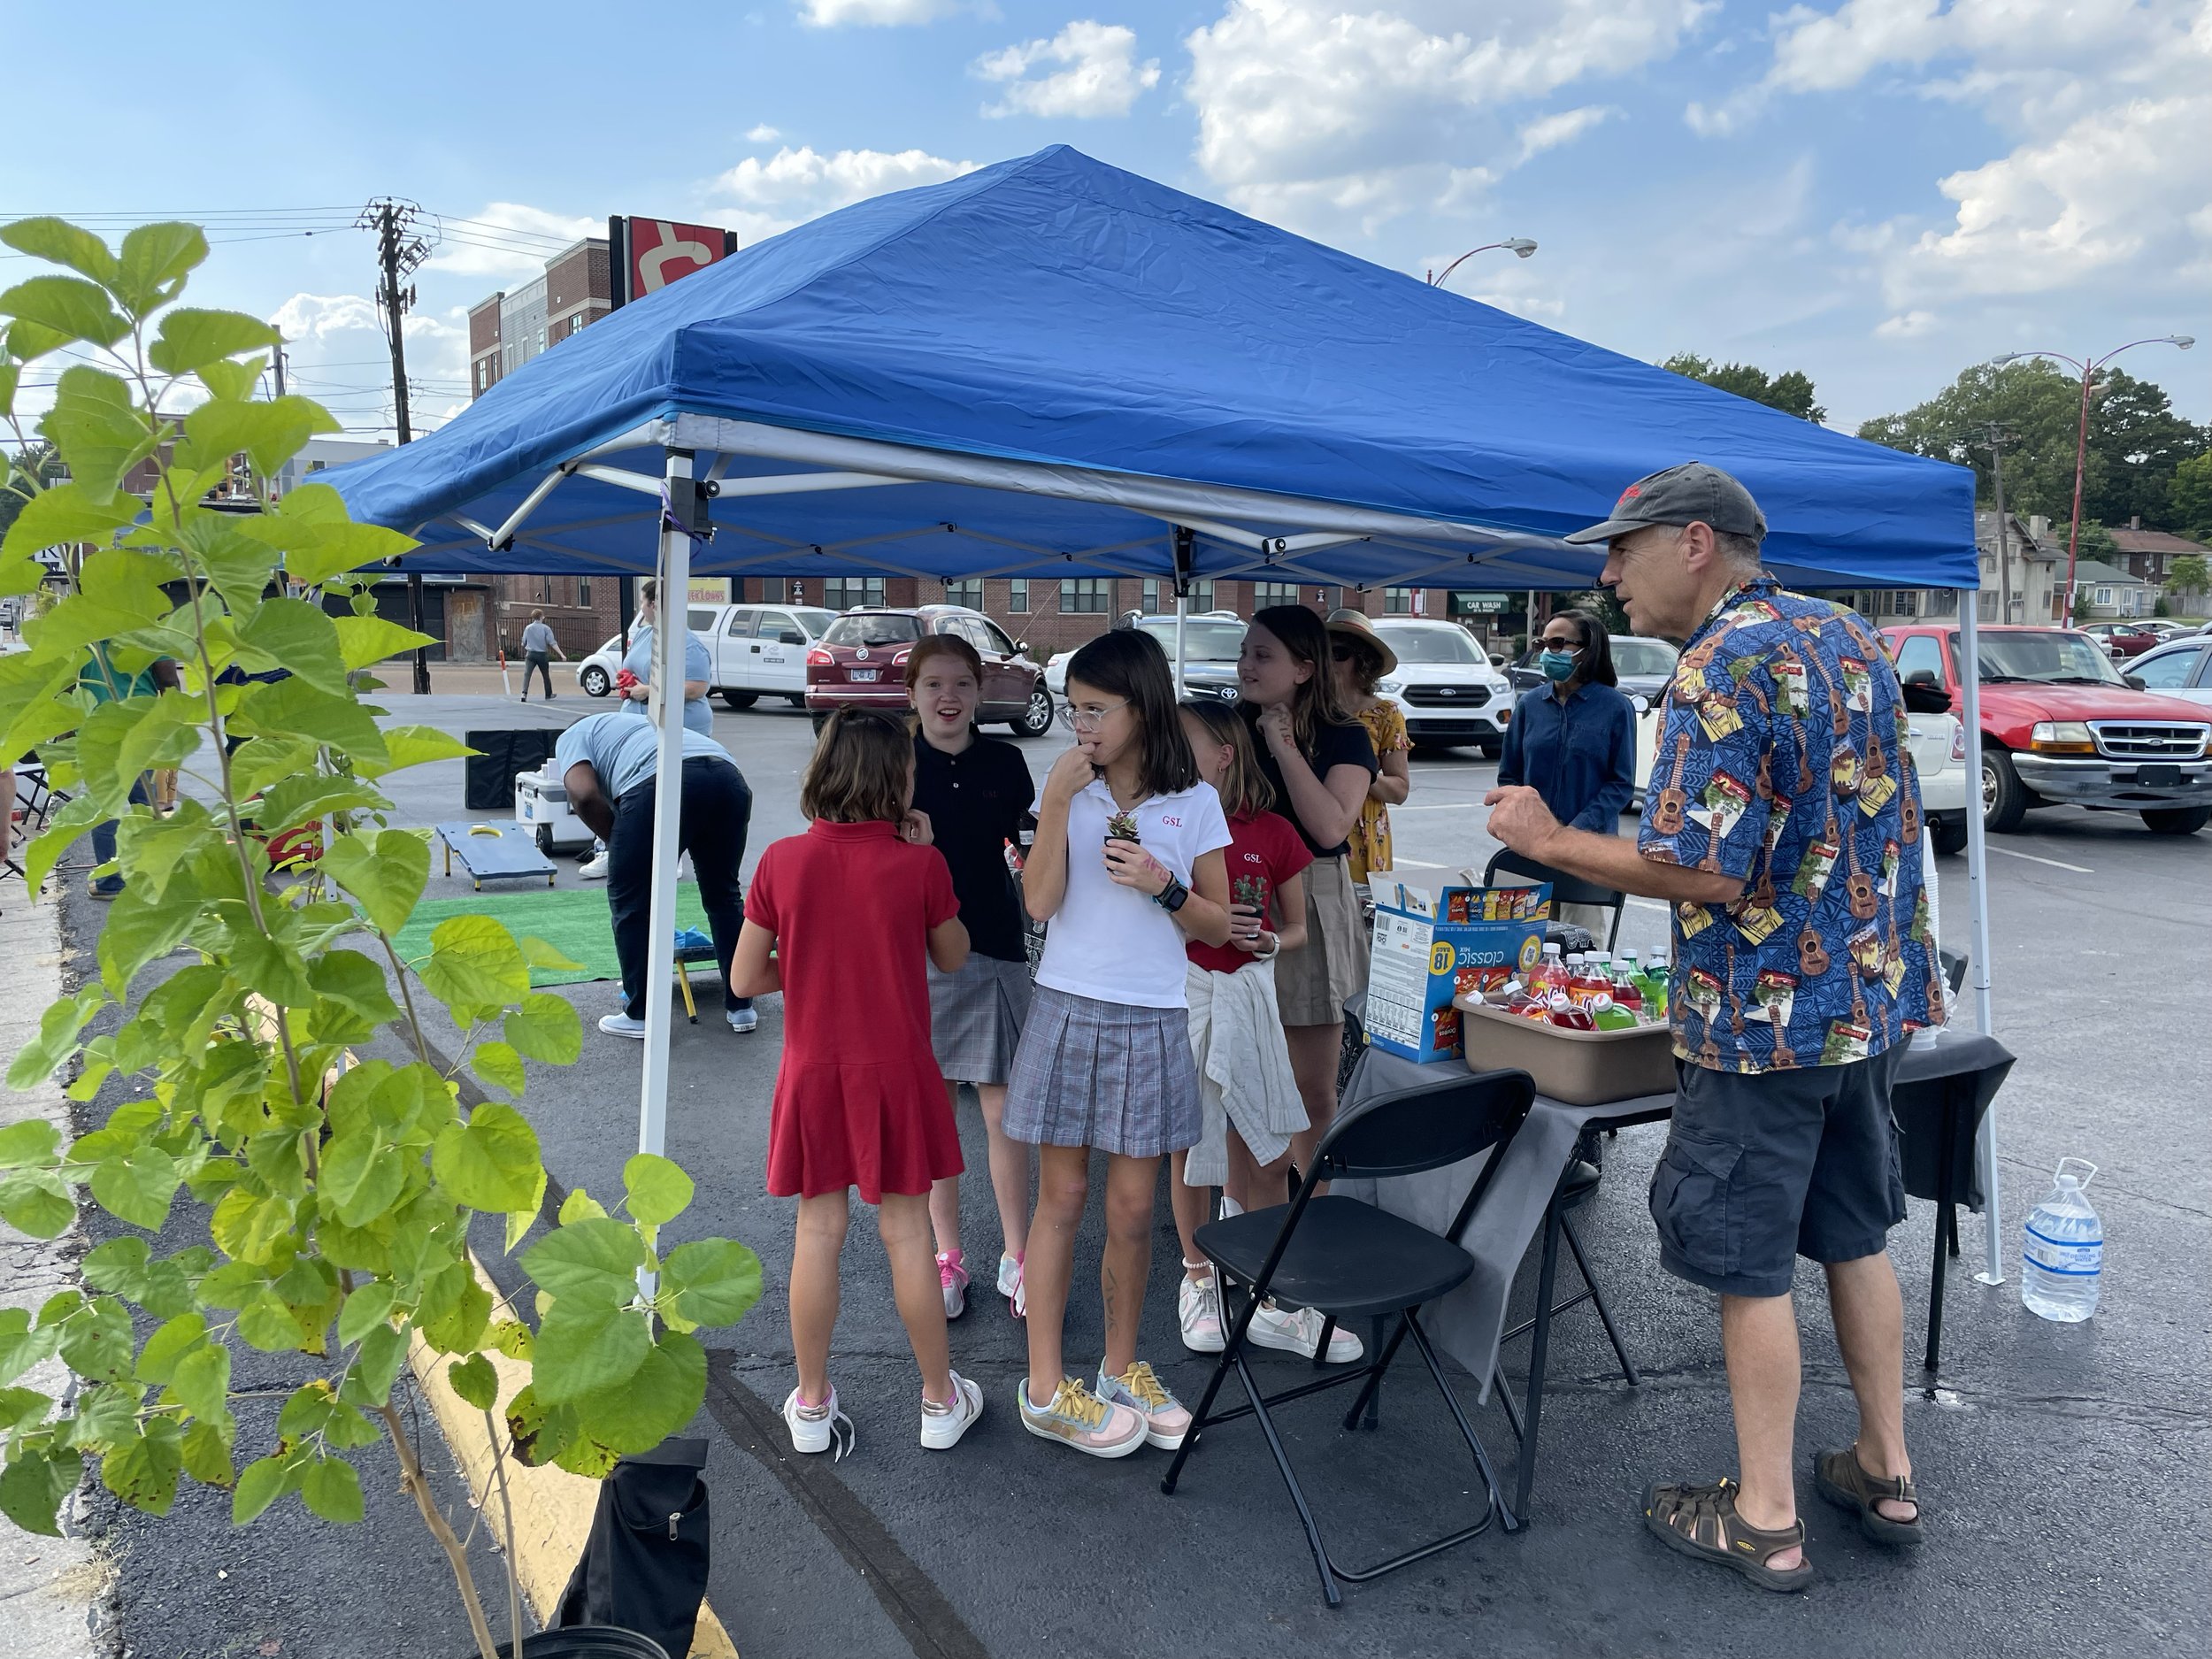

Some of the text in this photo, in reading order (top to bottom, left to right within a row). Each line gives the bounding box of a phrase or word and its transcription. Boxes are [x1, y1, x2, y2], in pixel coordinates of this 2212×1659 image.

[1162, 815, 1183, 828] GSL
[1243, 853, 1263, 864] GSL
[1433, 953, 1448, 971] 18
[1457, 950, 1504, 969] classic
